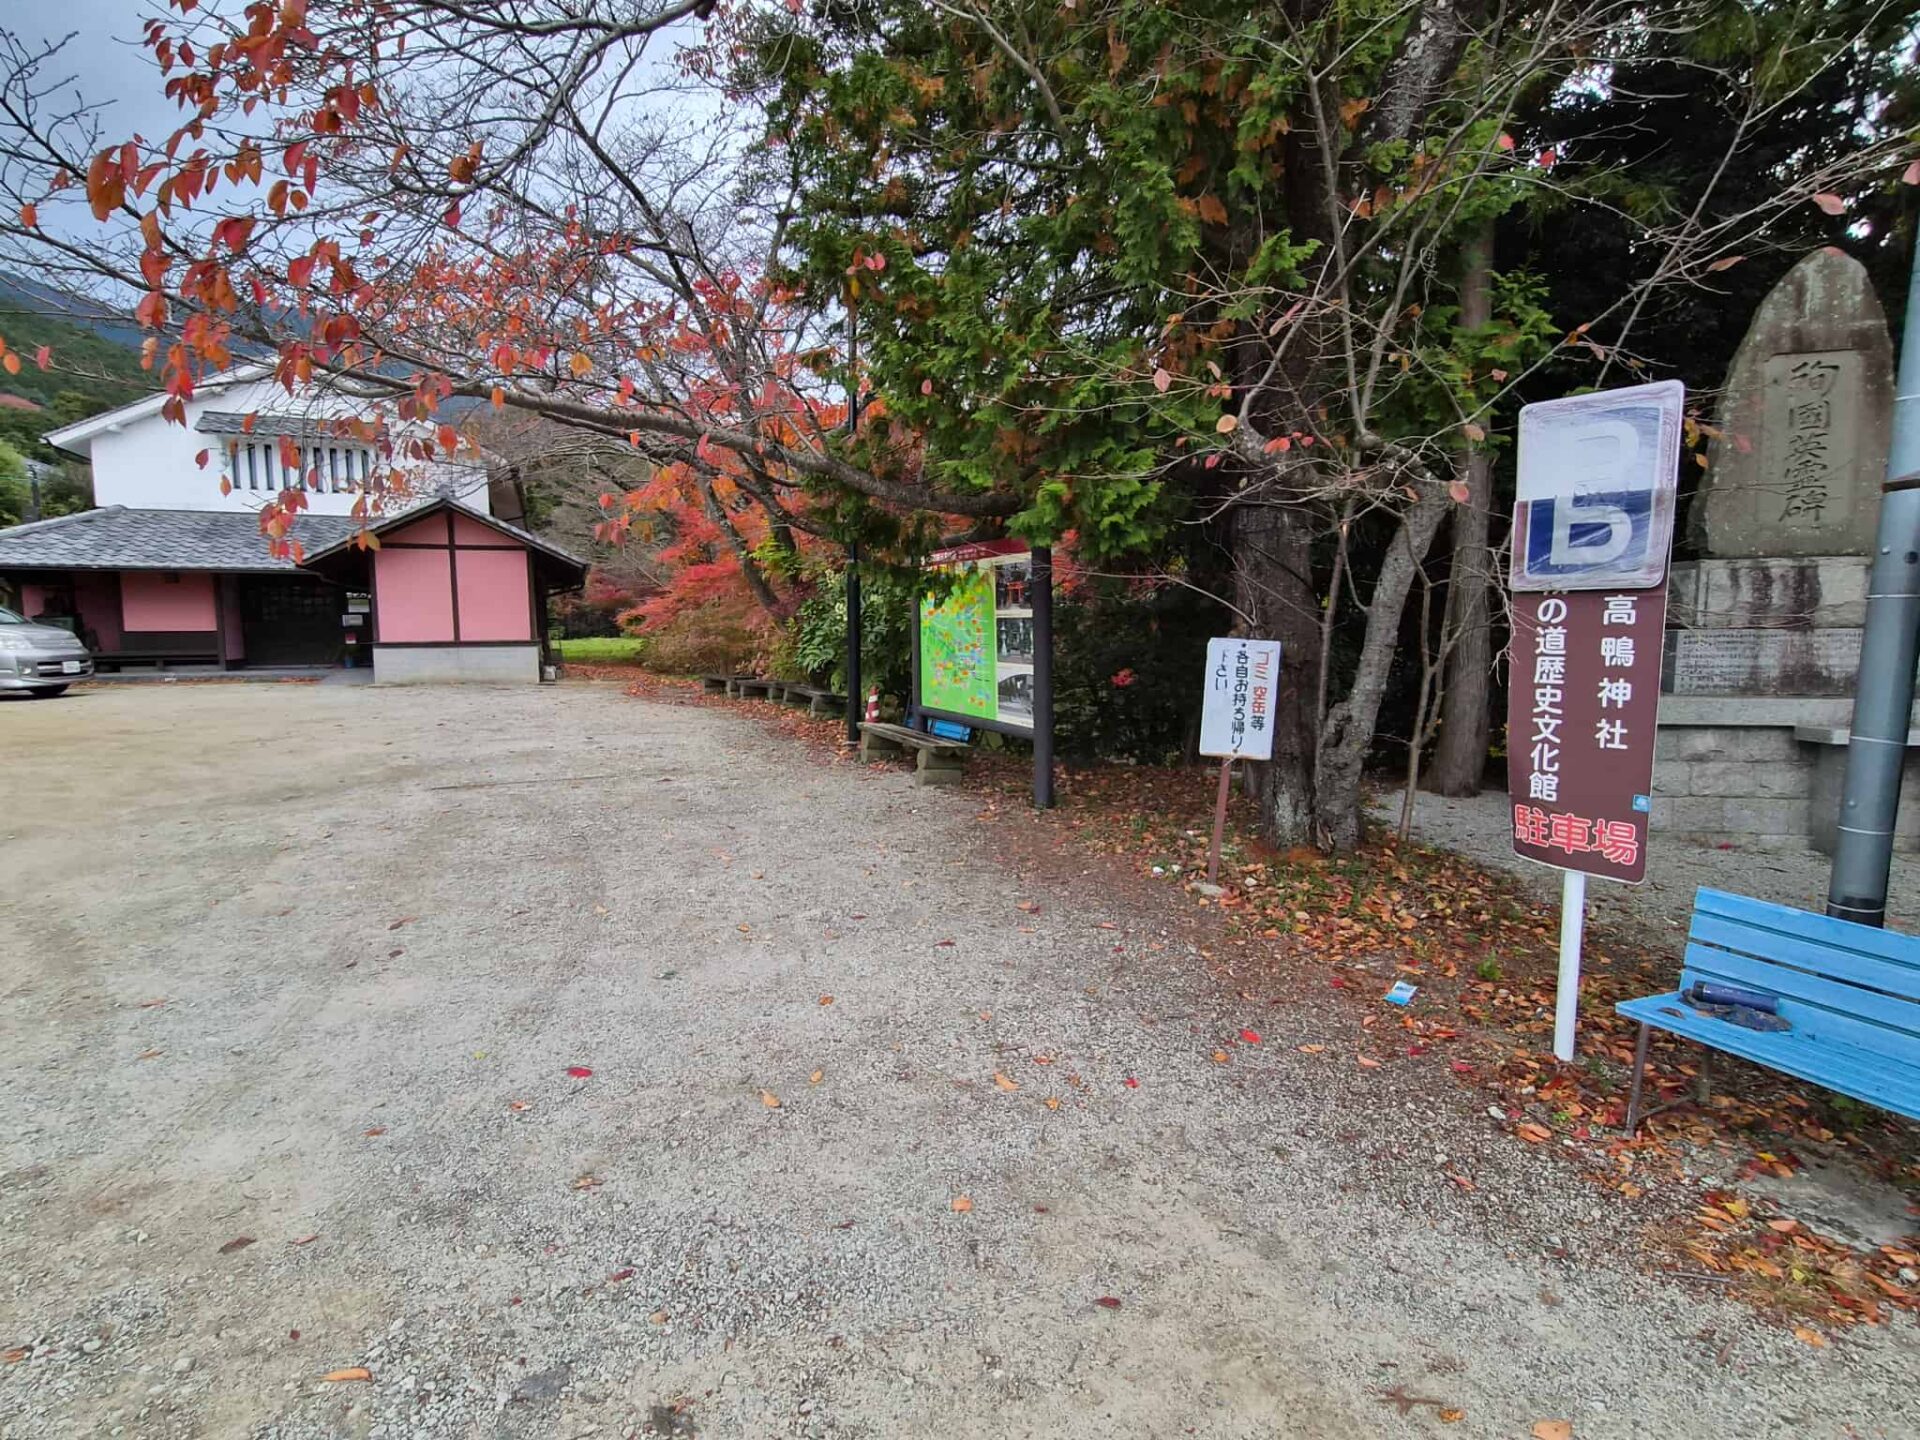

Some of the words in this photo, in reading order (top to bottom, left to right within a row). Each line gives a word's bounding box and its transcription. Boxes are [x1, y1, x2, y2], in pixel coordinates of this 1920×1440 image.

[1231, 650, 1250, 749] 各自お持ち帰り
[1528, 590, 1568, 802] の道歴史文化館
[1594, 594, 1638, 750] 高鴨神社
[1514, 803, 1639, 865] 駐車場
